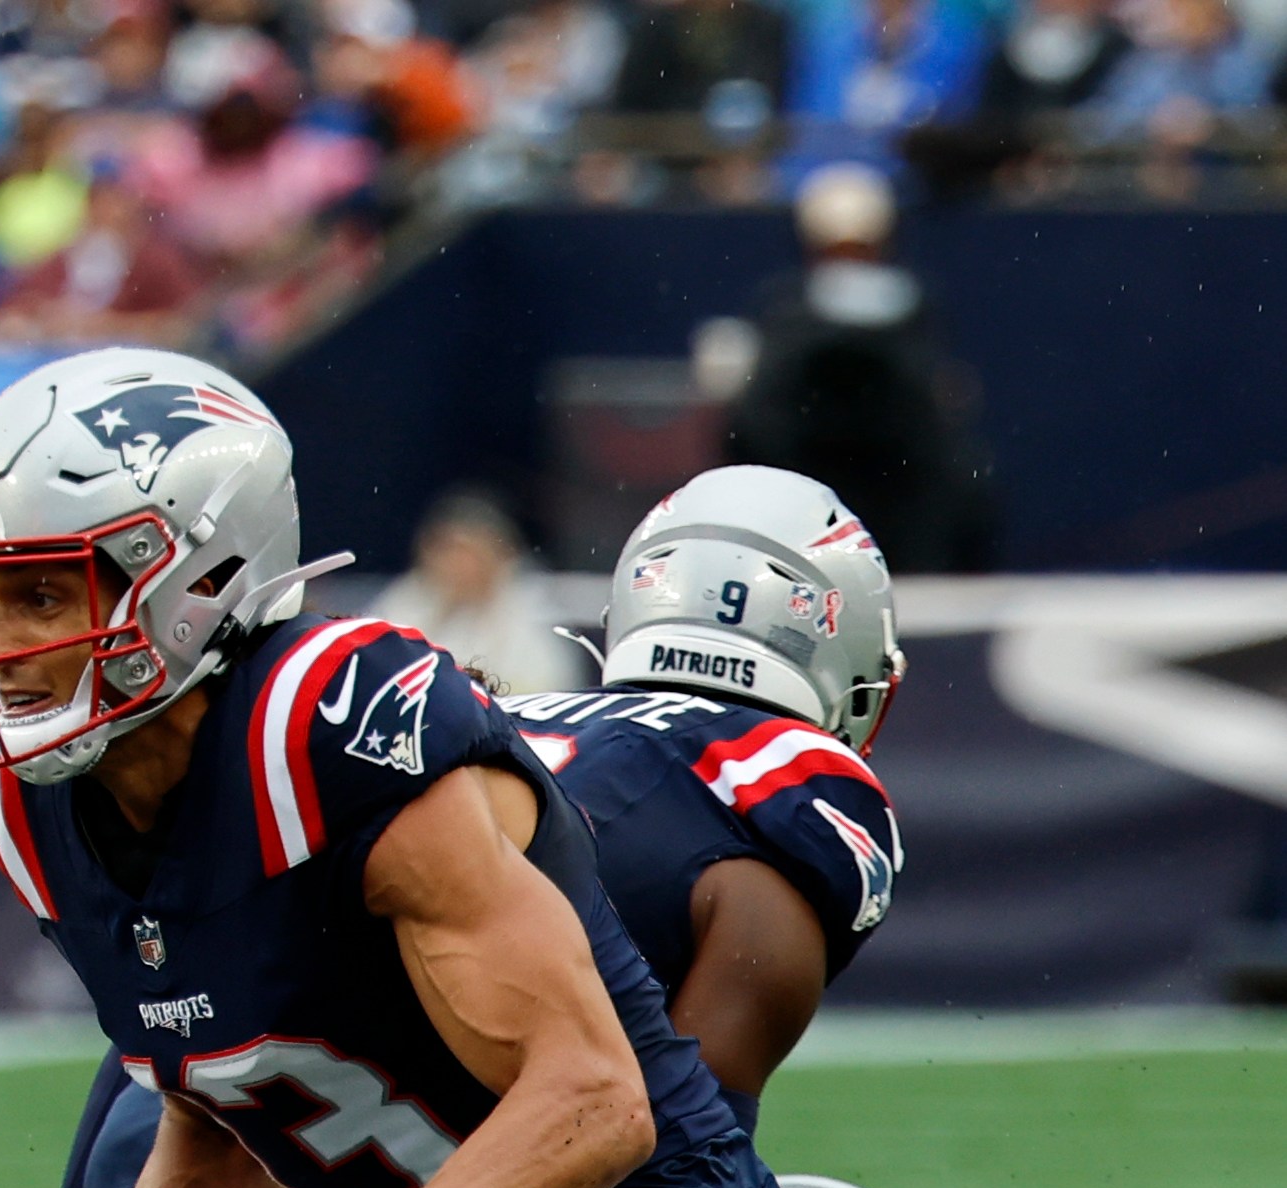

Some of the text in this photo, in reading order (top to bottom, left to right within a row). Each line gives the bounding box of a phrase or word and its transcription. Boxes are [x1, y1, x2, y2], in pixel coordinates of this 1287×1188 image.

[716, 580, 748, 625] 9
[649, 643, 758, 689] PATRIOTS
[138, 993, 215, 1030] PATRIOTS
